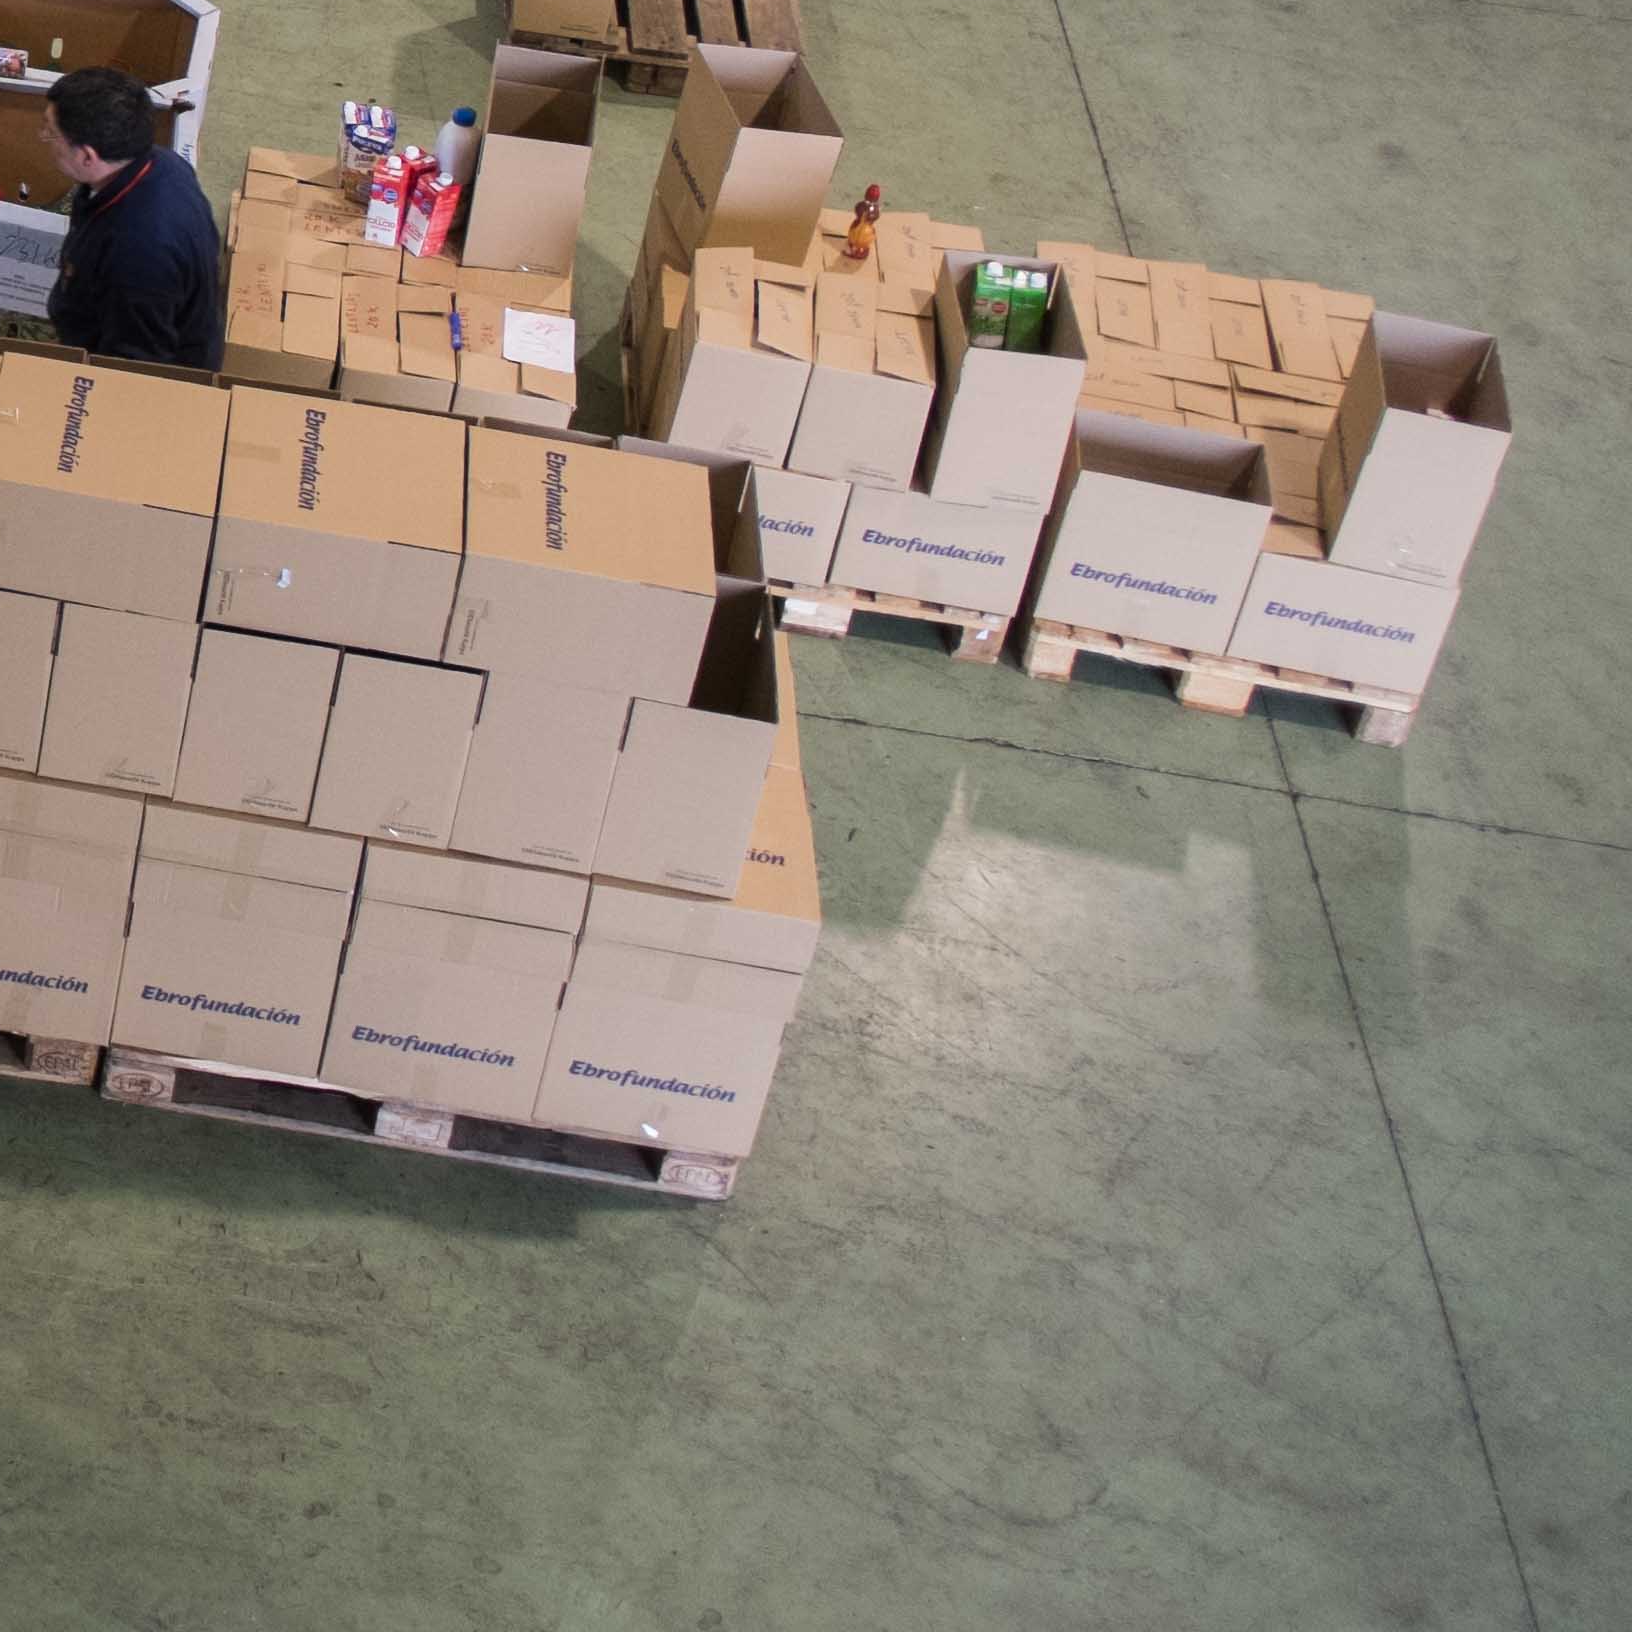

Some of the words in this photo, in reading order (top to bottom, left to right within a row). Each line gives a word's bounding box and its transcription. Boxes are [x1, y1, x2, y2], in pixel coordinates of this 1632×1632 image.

[57, 376, 94, 473] Ebrofundación
[297, 408, 326, 511] Ebrofundación
[540, 451, 568, 550] Ebrofundación
[862, 529, 1005, 567] Ebrofundación
[1070, 563, 1218, 606] Ebrofundación
[1264, 602, 1415, 644] Ebrofundación
[141, 985, 301, 1026] Ebrofundación
[352, 1026, 515, 1067] Ebrofundación
[569, 1060, 736, 1103] Ebrofundación
